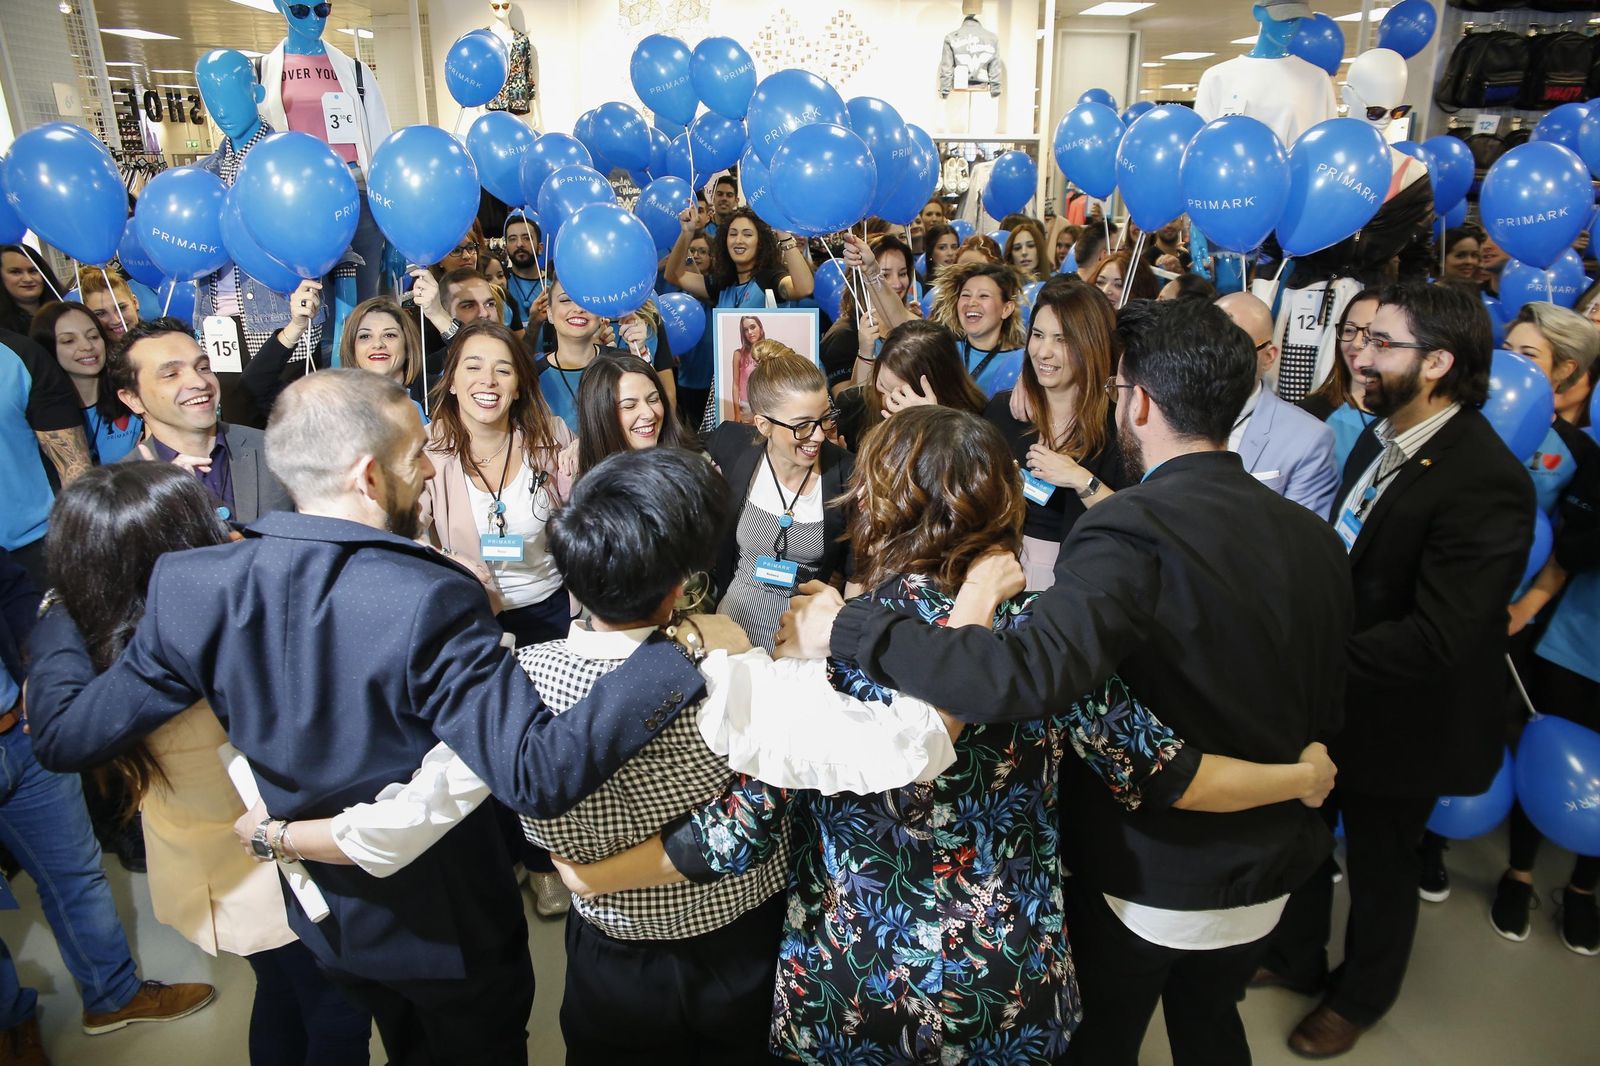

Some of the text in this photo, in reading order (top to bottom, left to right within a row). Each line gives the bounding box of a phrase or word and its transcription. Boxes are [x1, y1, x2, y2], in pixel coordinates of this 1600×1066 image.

[764, 107, 822, 145] PRIMARK
[1118, 156, 1136, 173] ARK
[559, 175, 607, 189] PRIMARK
[1316, 163, 1377, 204] PRIMARK
[1187, 197, 1255, 210] PRIMARK
[1497, 207, 1568, 227] PRIMARK
[152, 227, 218, 254] PRIMARK
[583, 281, 646, 305] PRIMARK
[1527, 283, 1577, 294] PRIMARK
[661, 300, 687, 333] PRIMARK
[212, 340, 238, 357] 15€
